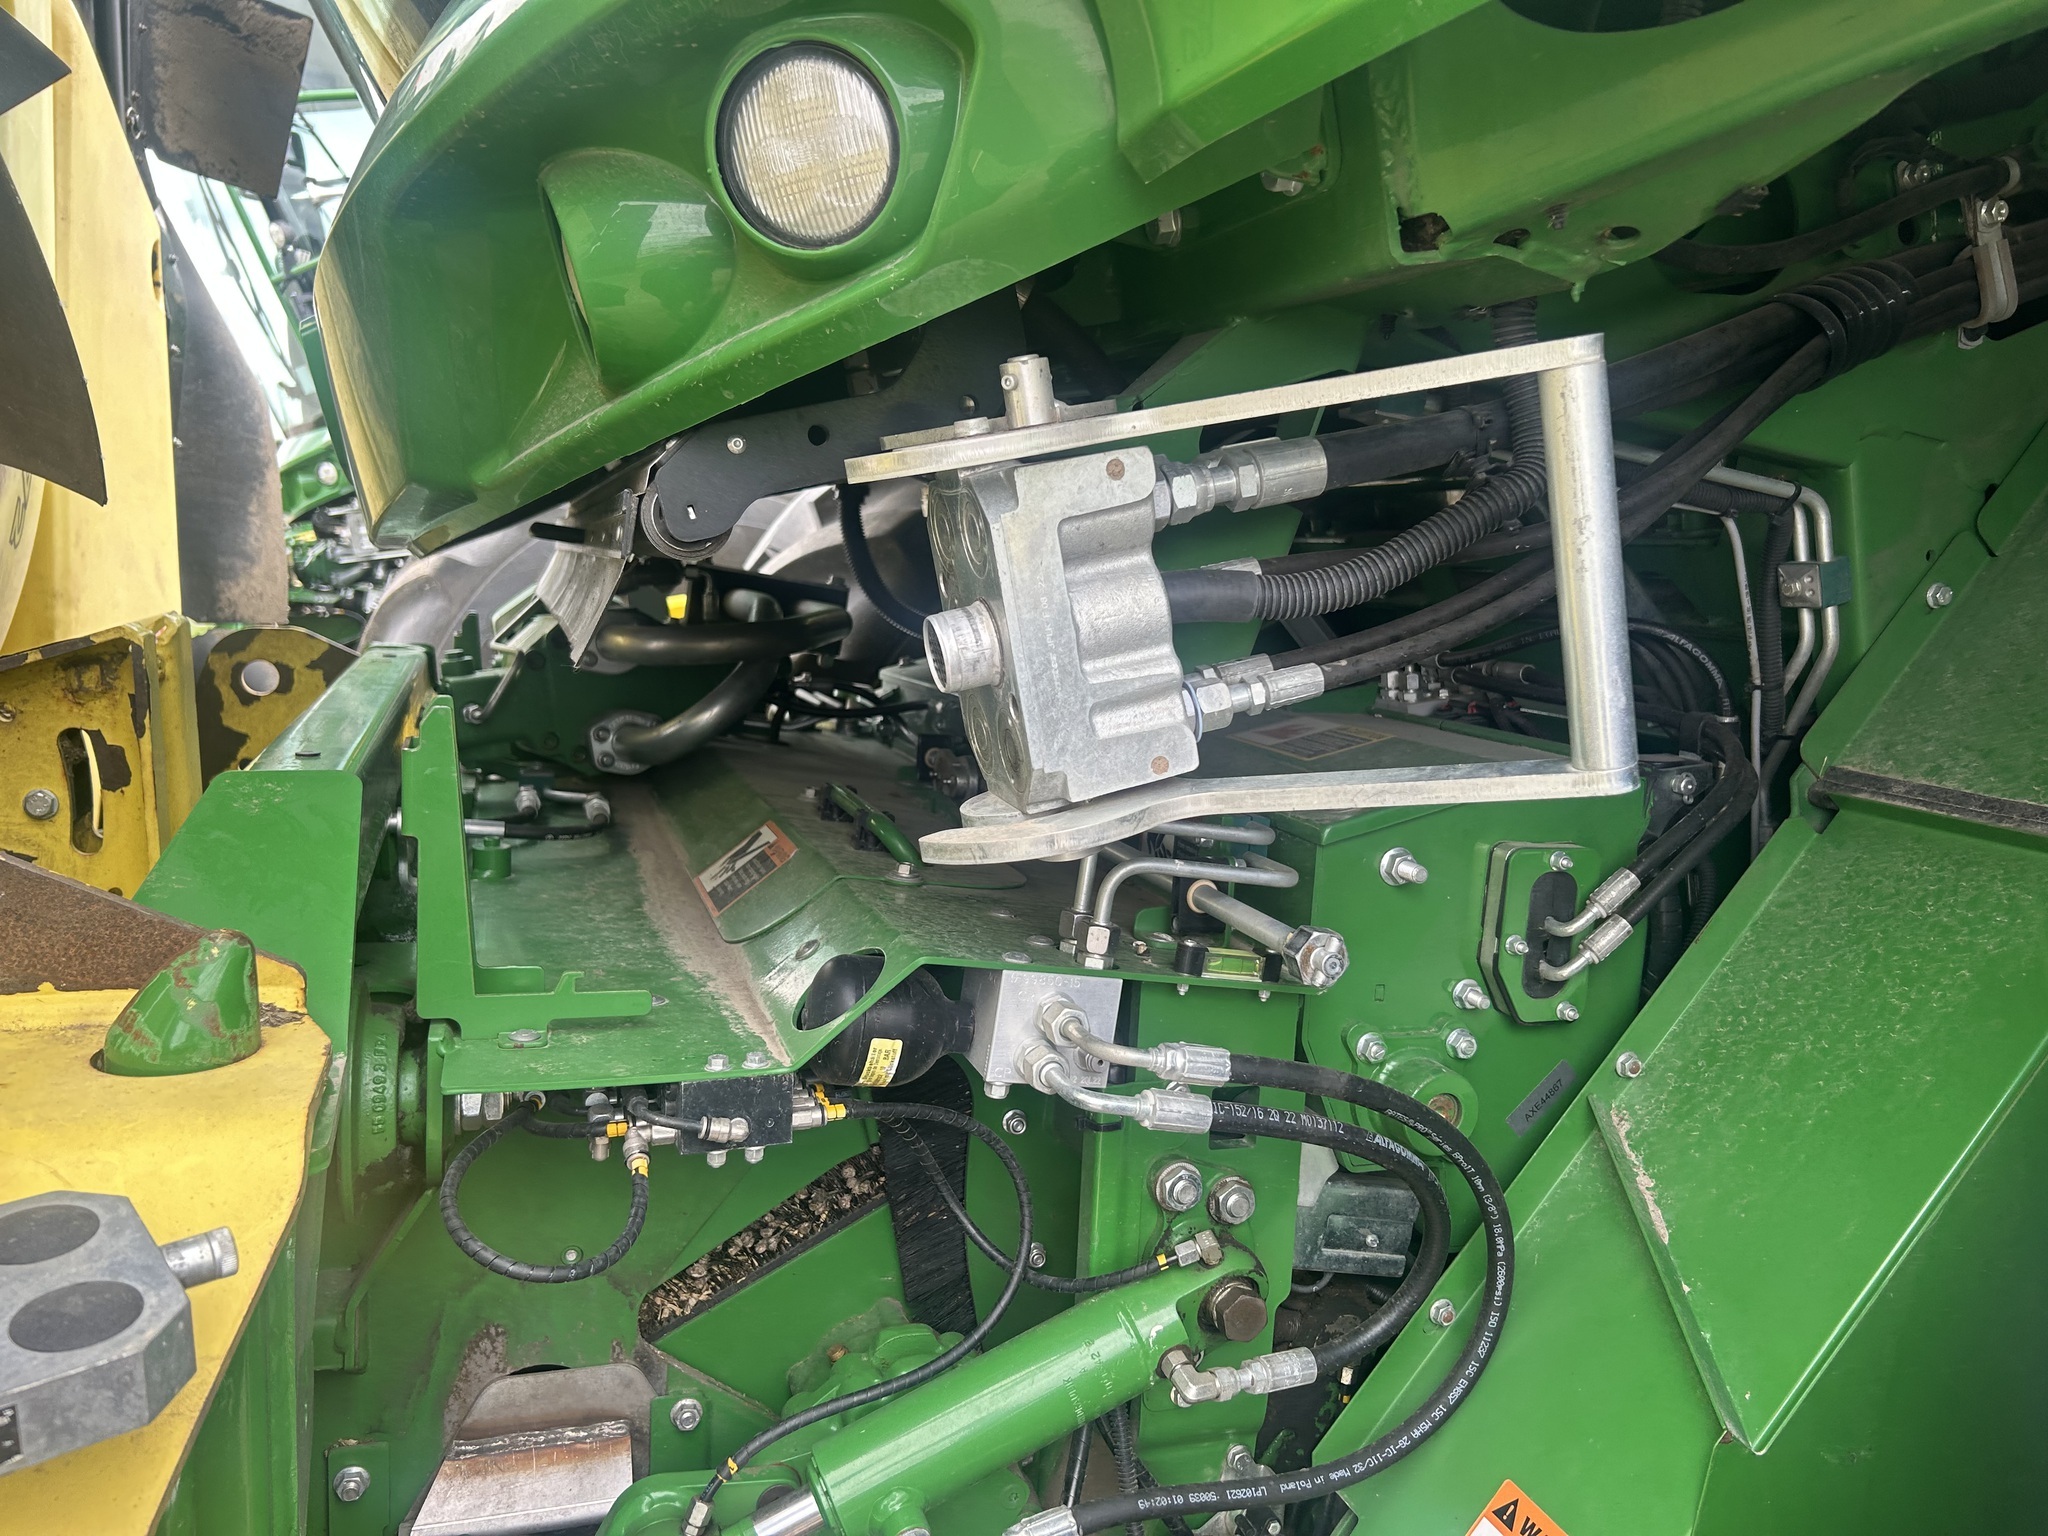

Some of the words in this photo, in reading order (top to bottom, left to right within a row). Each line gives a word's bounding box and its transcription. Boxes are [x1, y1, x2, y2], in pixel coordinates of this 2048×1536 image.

[1663, 633, 1724, 690] ALFAGOMMA
[1524, 1078, 1564, 1122] AXE44867
[1284, 1110, 1297, 1125] 22
[1494, 1261, 1506, 1307] (2600psi)
[1488, 1310, 1501, 1328] ISO
[1478, 1331, 1494, 1359] 11237
[1448, 1378, 1469, 1405] EN857
[1411, 1418, 1433, 1440] MSHA
[1313, 1474, 1326, 1486] in
[1328, 1466, 1352, 1483] Made
[1226, 1486, 1268, 1500] LP102621
[1280, 1478, 1314, 1494] Poland
[1137, 1496, 1184, 1510] 01:02:49
